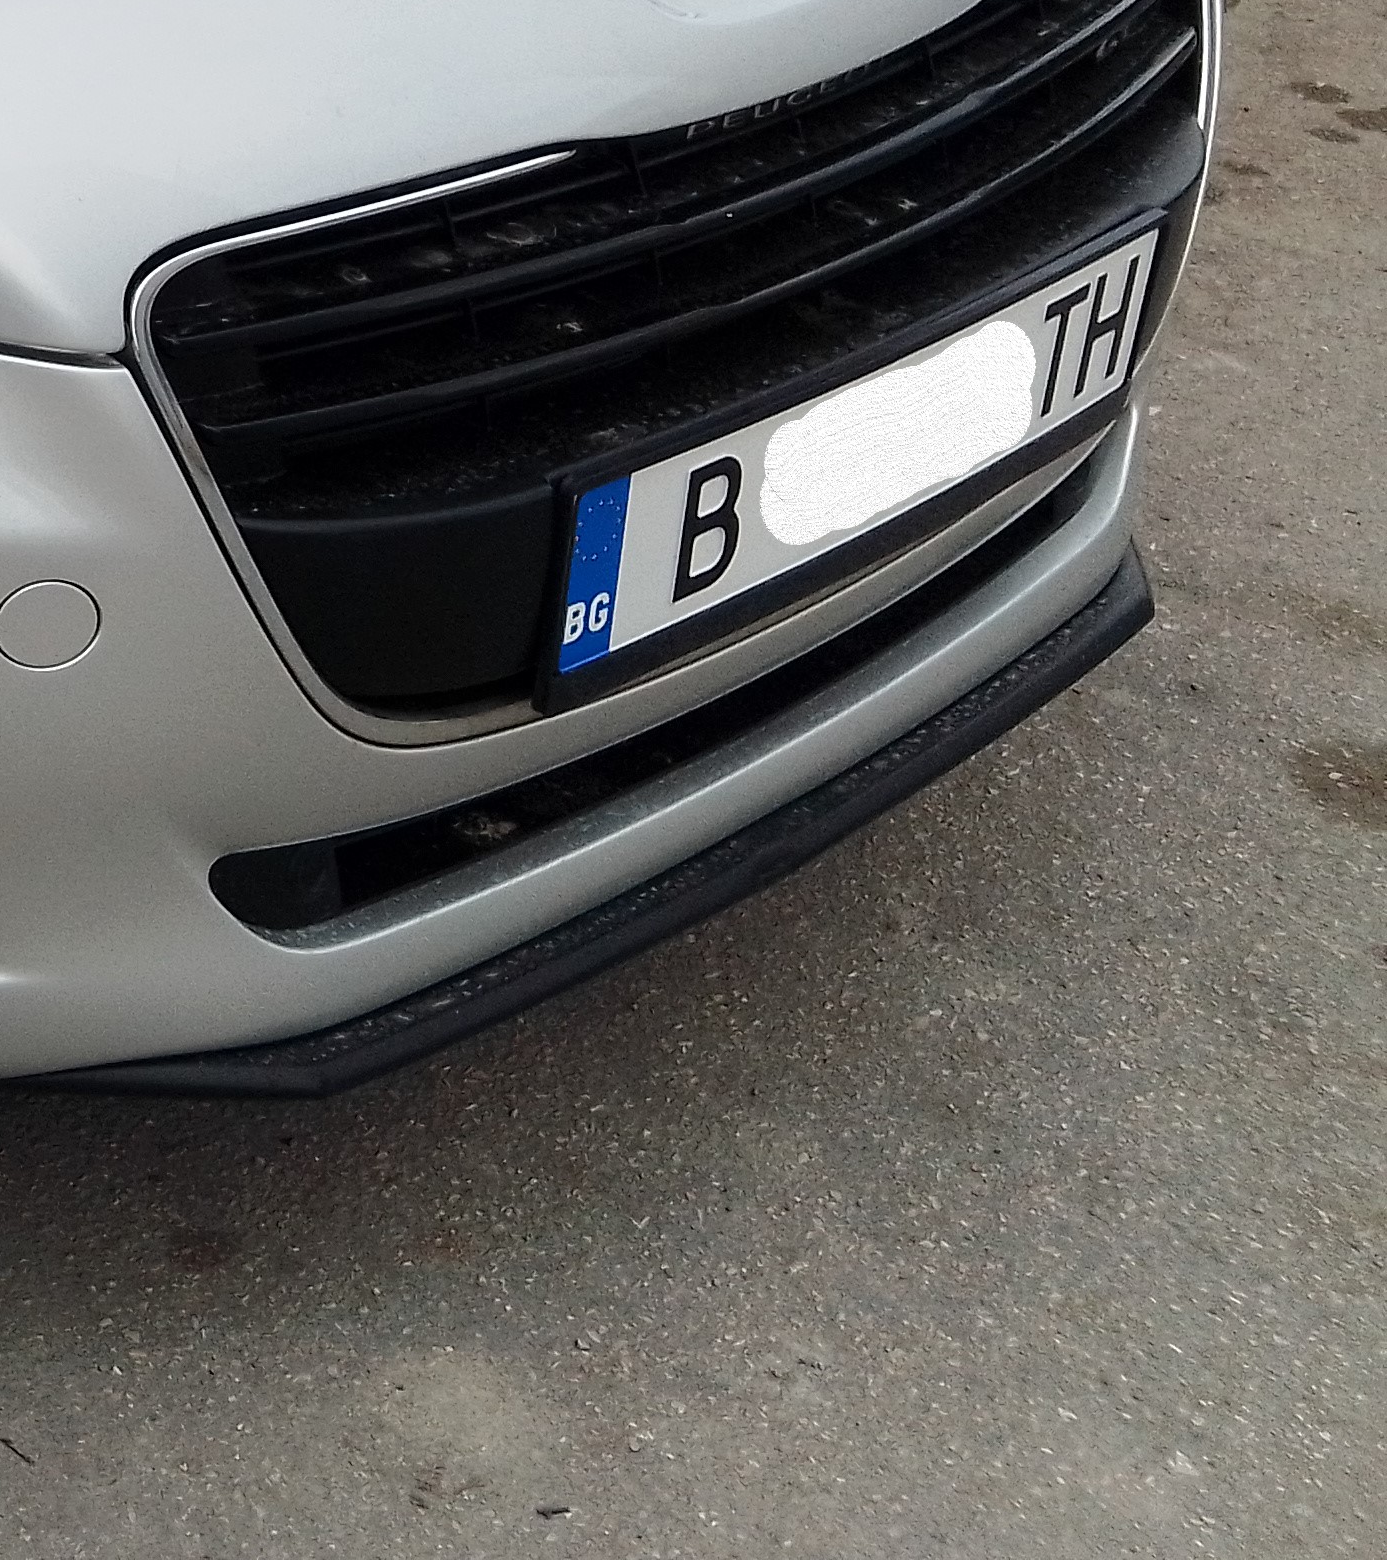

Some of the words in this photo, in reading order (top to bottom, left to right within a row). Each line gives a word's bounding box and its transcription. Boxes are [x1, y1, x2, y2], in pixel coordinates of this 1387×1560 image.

[1039, 254, 1141, 418] TH
[671, 454, 742, 604] B
[562, 591, 611, 645] BG
